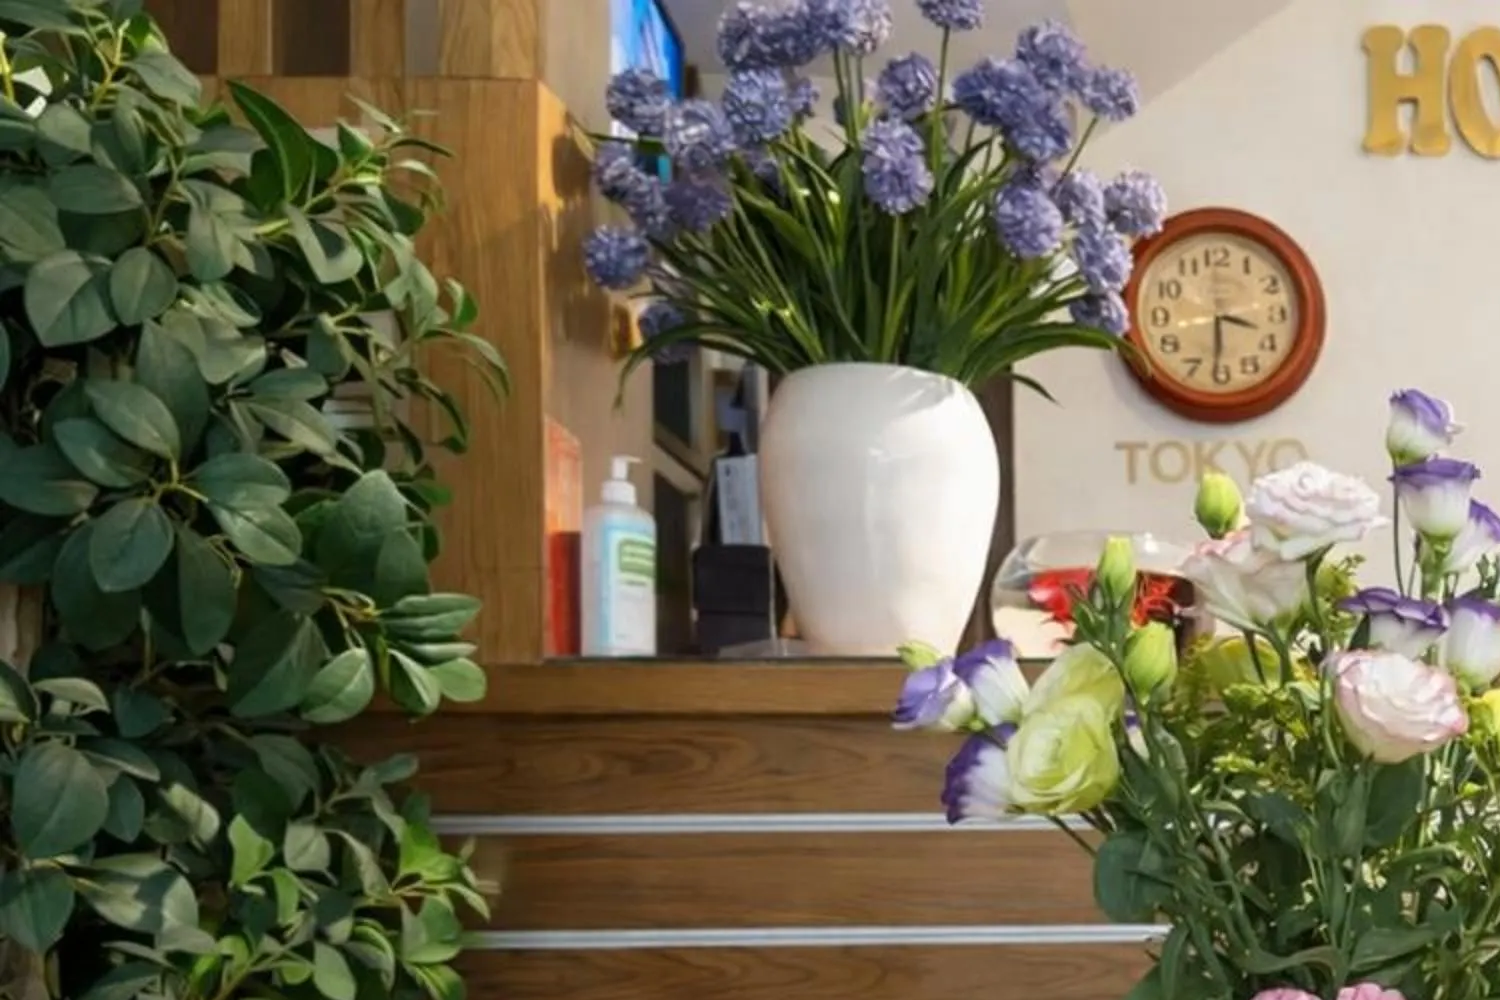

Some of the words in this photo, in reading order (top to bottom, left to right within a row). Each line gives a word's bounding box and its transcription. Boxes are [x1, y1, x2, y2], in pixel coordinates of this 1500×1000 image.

[1179, 258, 1198, 277] 11
[1204, 248, 1231, 268] 12
[1242, 256, 1252, 275] 1
[1158, 280, 1182, 299] 10
[1259, 276, 1280, 294] 2
[1152, 307, 1170, 327] 9
[1269, 305, 1287, 324] 3
[1160, 334, 1179, 353] 8
[1258, 334, 1277, 352] 4
[1183, 358, 1203, 377] 7
[1240, 355, 1260, 375] 5
